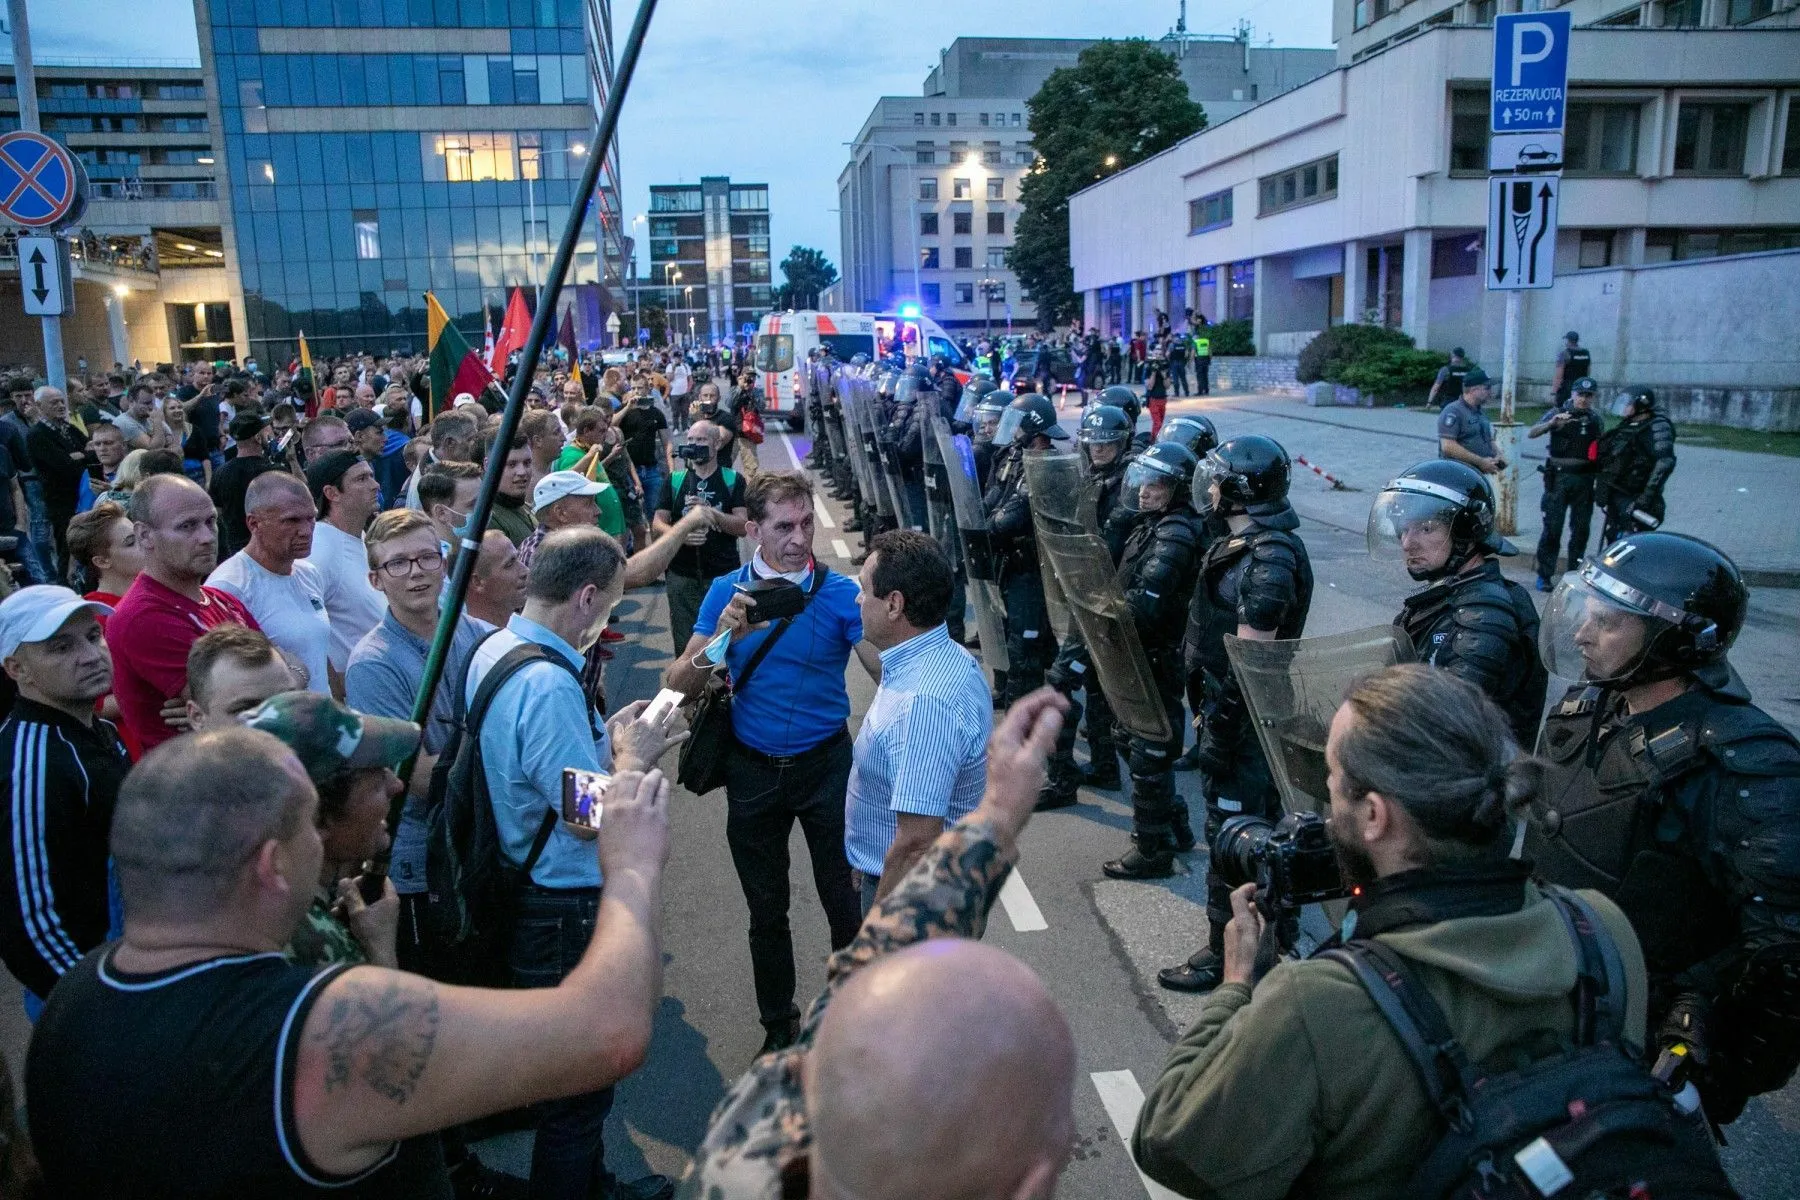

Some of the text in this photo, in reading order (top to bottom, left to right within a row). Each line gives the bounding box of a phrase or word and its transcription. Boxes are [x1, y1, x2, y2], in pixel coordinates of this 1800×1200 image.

[1511, 21, 1555, 87] P
[1495, 87, 1562, 102] REZERVUOTA
[1514, 108, 1543, 121] 50 m
